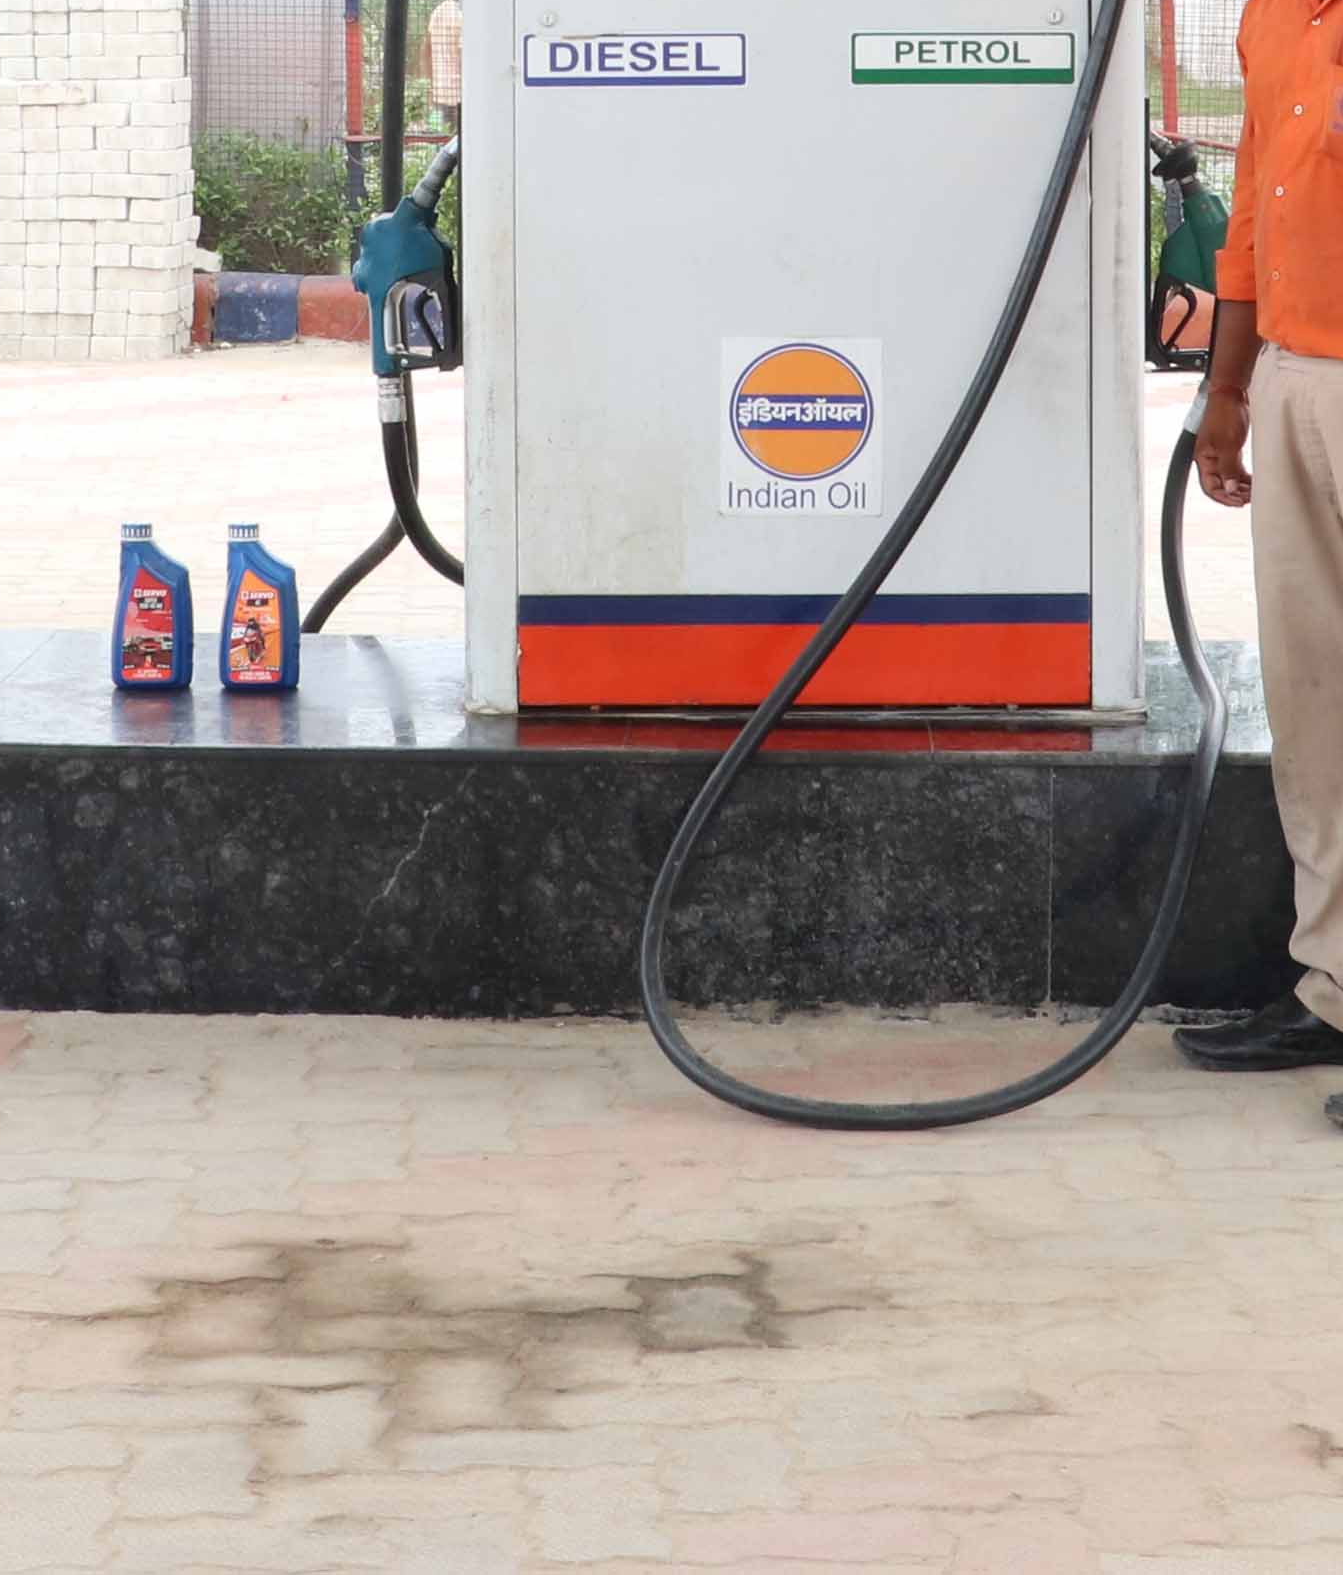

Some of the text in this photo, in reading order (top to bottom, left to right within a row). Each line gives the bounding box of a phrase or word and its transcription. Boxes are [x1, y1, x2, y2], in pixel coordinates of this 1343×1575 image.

[549, 41, 720, 73] DIESEL
[894, 40, 1031, 64] PETROL
[728, 481, 866, 509] Indian Oil
